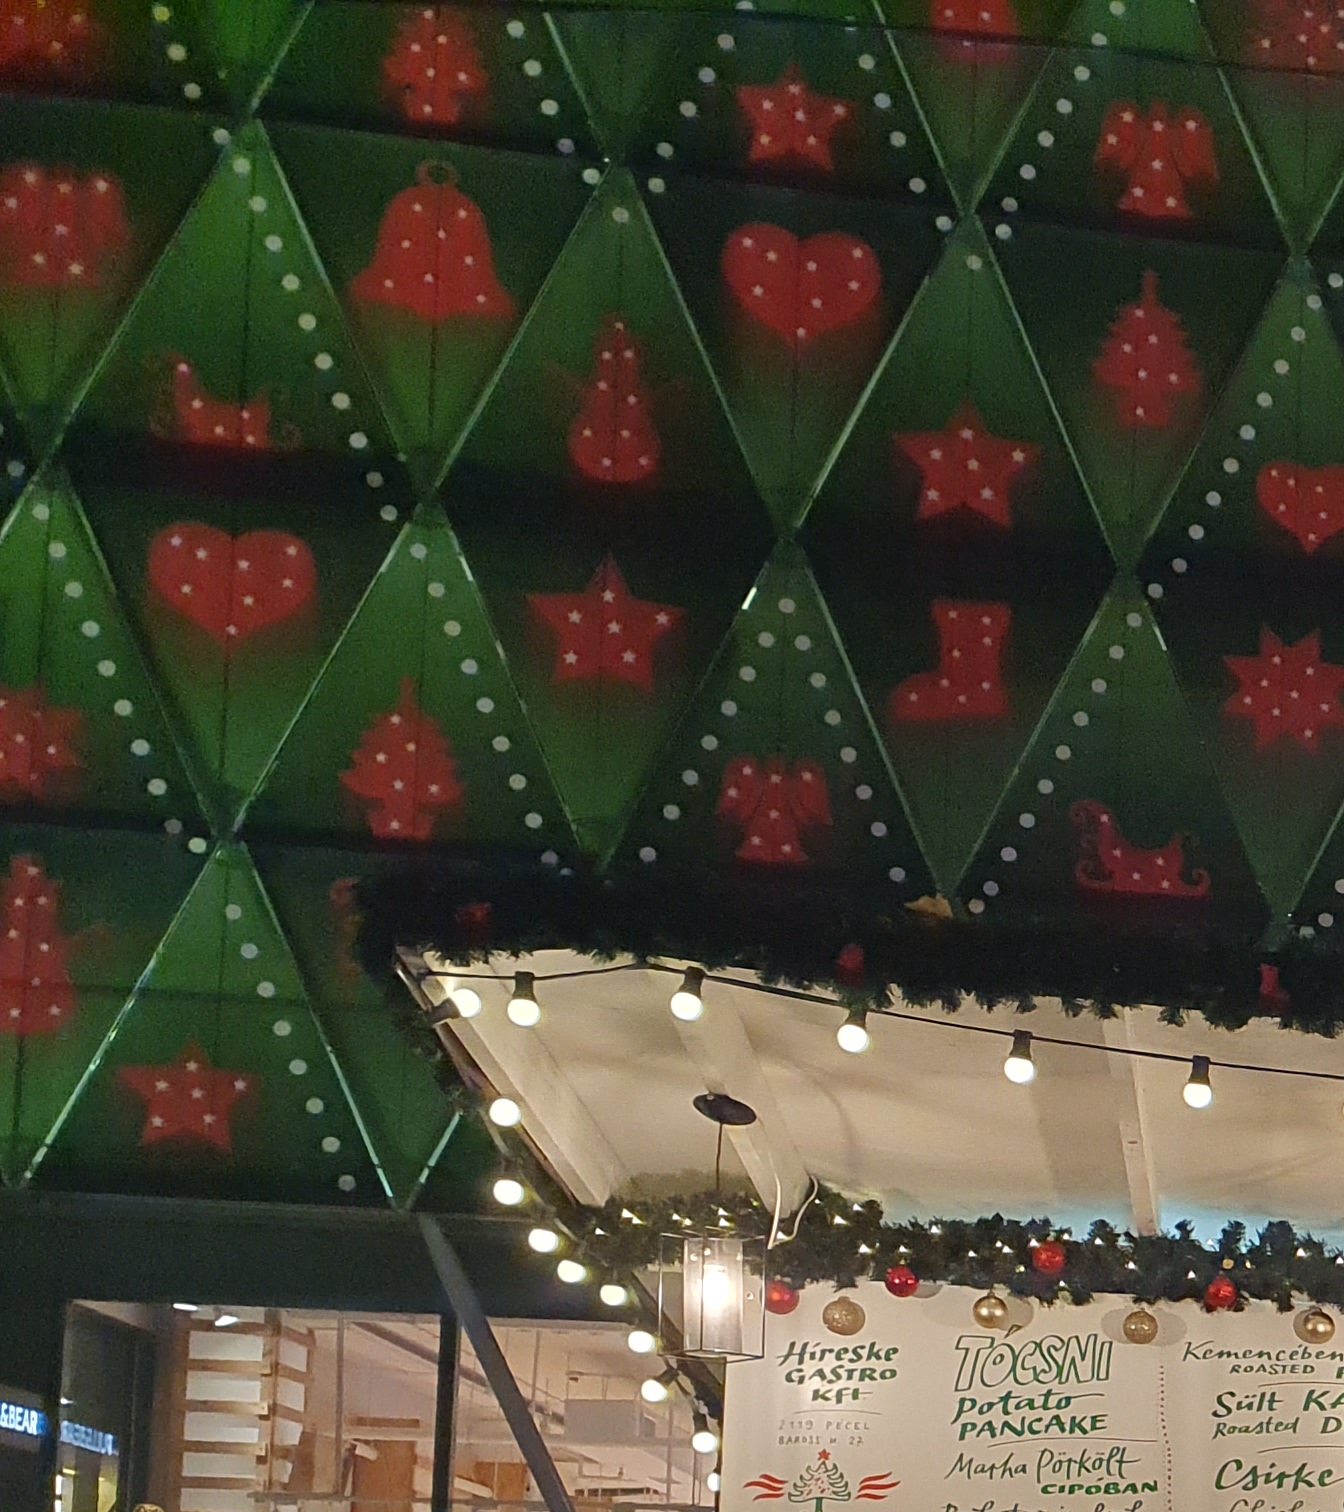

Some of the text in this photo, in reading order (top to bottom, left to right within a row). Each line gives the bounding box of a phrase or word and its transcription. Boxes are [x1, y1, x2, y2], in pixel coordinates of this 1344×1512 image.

[954, 1324, 1113, 1392] TÓCSNI
[1182, 1340, 1344, 1362] Kemencében
[785, 1364, 898, 1385] GASTRO
[1229, 1364, 1315, 1375] ROASTED
[1211, 1391, 1283, 1418] Sült
[959, 1414, 1108, 1441] PANCAKE
[1212, 1417, 1300, 1440] Roasted
[944, 1453, 1027, 1480] Marha
[1041, 1478, 1158, 1495] CIPÓBAN
